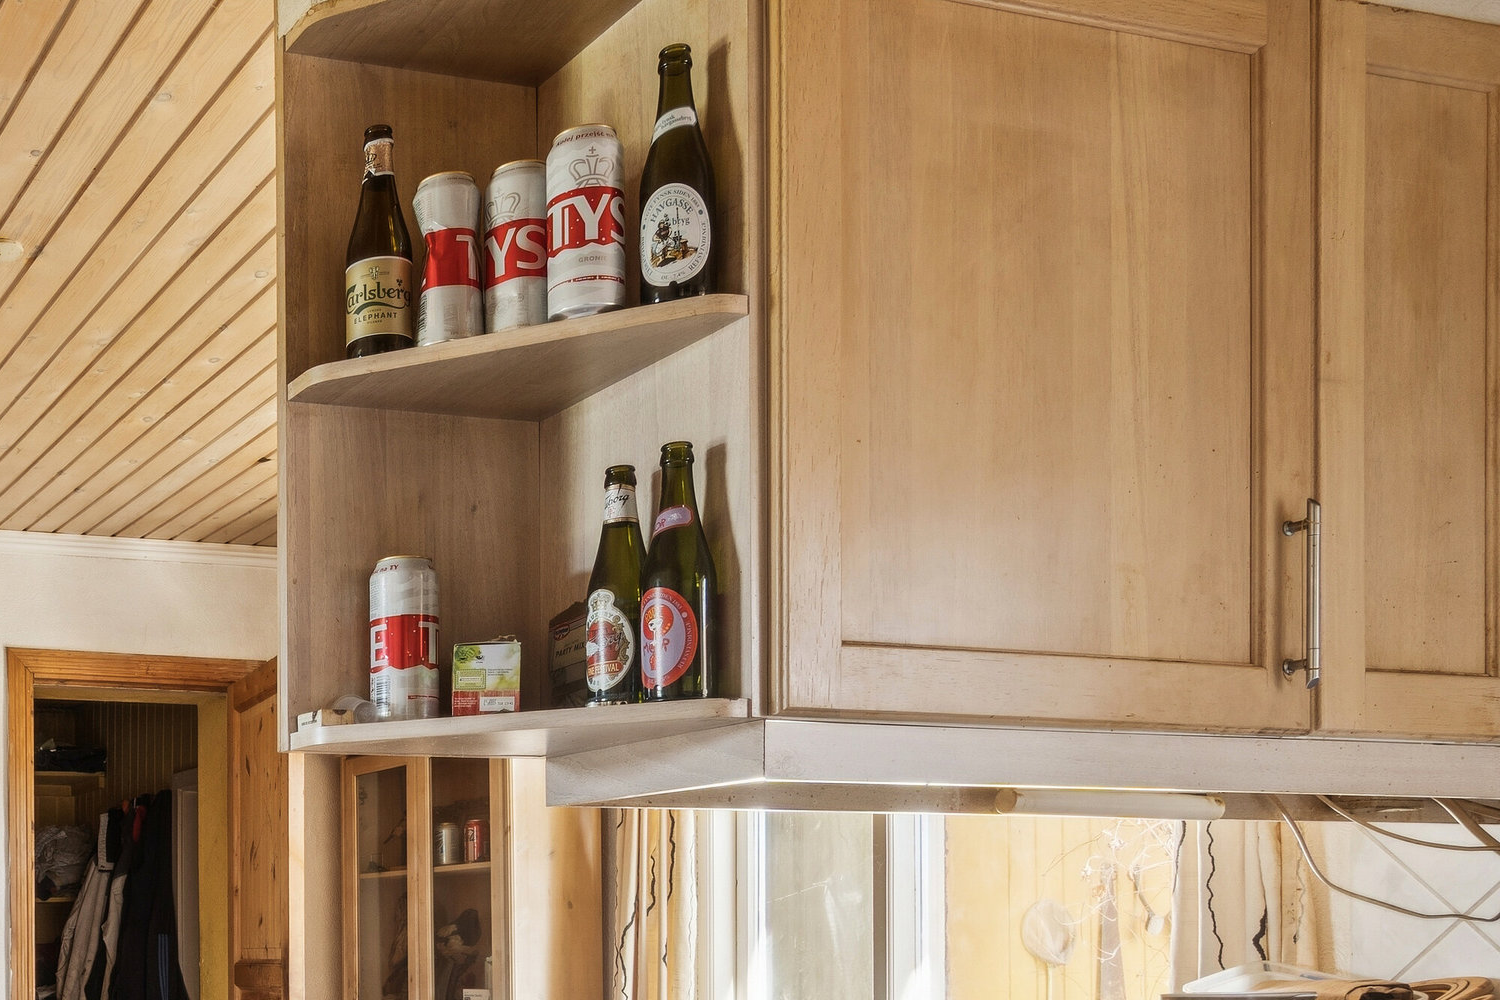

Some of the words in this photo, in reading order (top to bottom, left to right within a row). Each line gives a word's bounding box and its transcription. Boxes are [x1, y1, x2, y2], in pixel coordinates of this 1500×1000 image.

[650, 198, 694, 223] HAVGASSE
[672, 217, 691, 228] bryg
[346, 281, 412, 315] Carlsberg
[353, 311, 398, 325] ELEPHANT
[555, 647, 572, 657] PARTY
